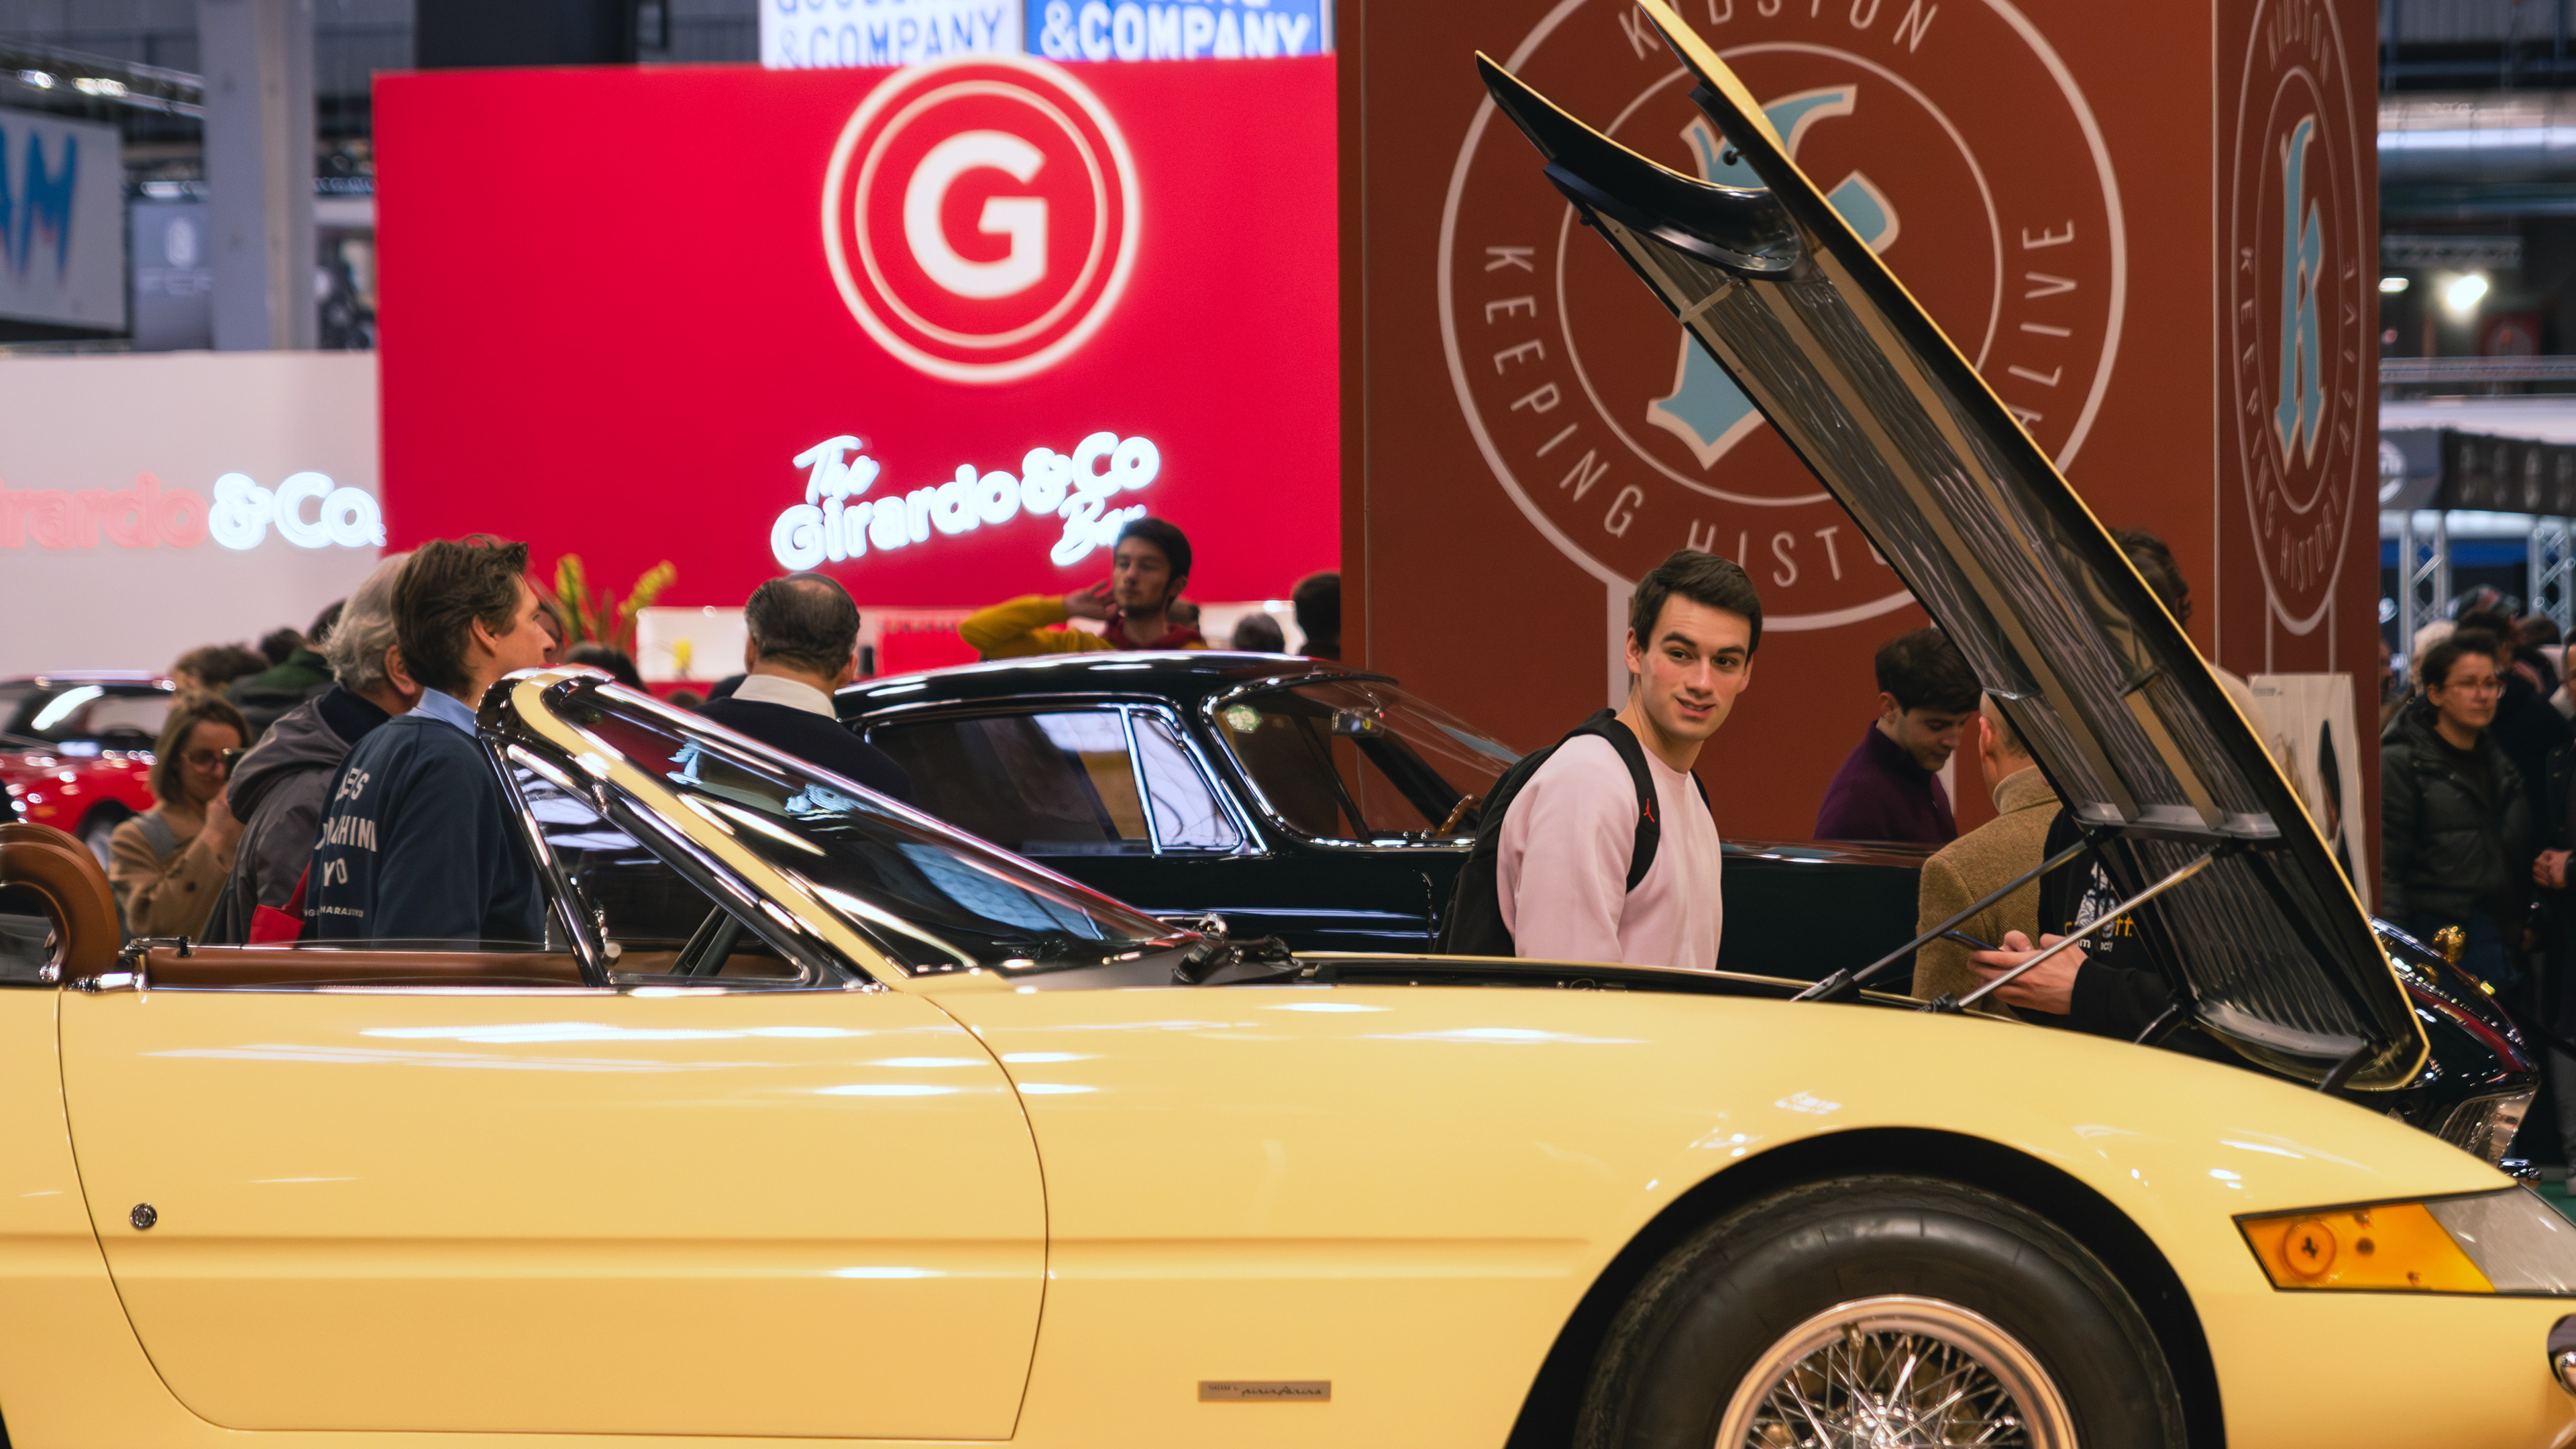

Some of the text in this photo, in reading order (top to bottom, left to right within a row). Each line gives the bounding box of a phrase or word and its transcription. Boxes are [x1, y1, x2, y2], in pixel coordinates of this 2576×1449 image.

[904, 130, 1049, 299] G
[1484, 246, 1644, 539] KEEPING
[1685, 519, 1888, 588] HIST
